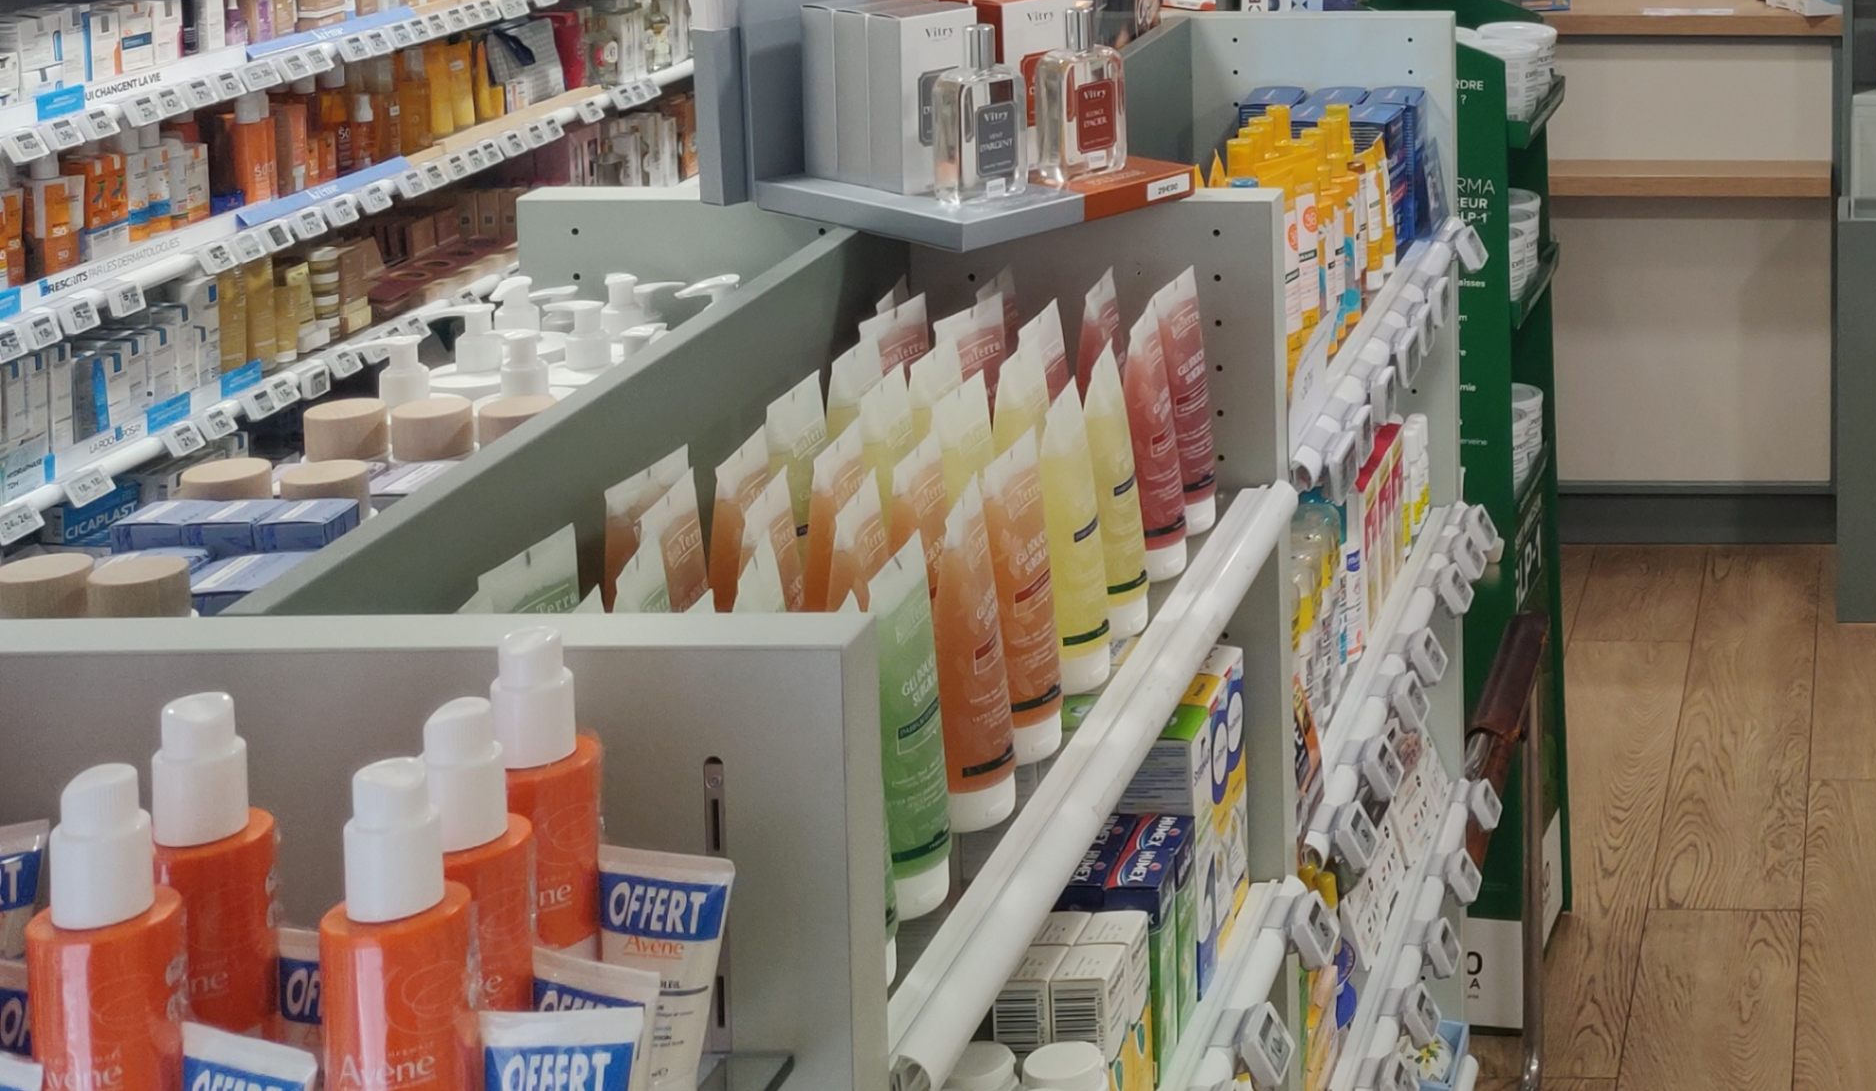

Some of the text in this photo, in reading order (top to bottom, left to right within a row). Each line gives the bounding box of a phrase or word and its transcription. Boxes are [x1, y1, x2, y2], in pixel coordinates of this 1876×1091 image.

[925, 25, 953, 39] Vitry
[1027, 10, 1055, 23] Vitry
[95, 81, 137, 100] CHANGENT
[137, 77, 149, 88] LA
[149, 72, 162, 86] VIE
[1083, 88, 1107, 100] Vitry
[983, 109, 1009, 123] Vitry
[65, 500, 138, 541] CICAPLAST
[1147, 815, 1178, 847] HUMEX
[1071, 850, 1102, 882] HUMEX
[1128, 850, 1157, 883] HUMEX
[608, 881, 707, 935] OFFERT
[501, 1052, 612, 1091] OFFERT
